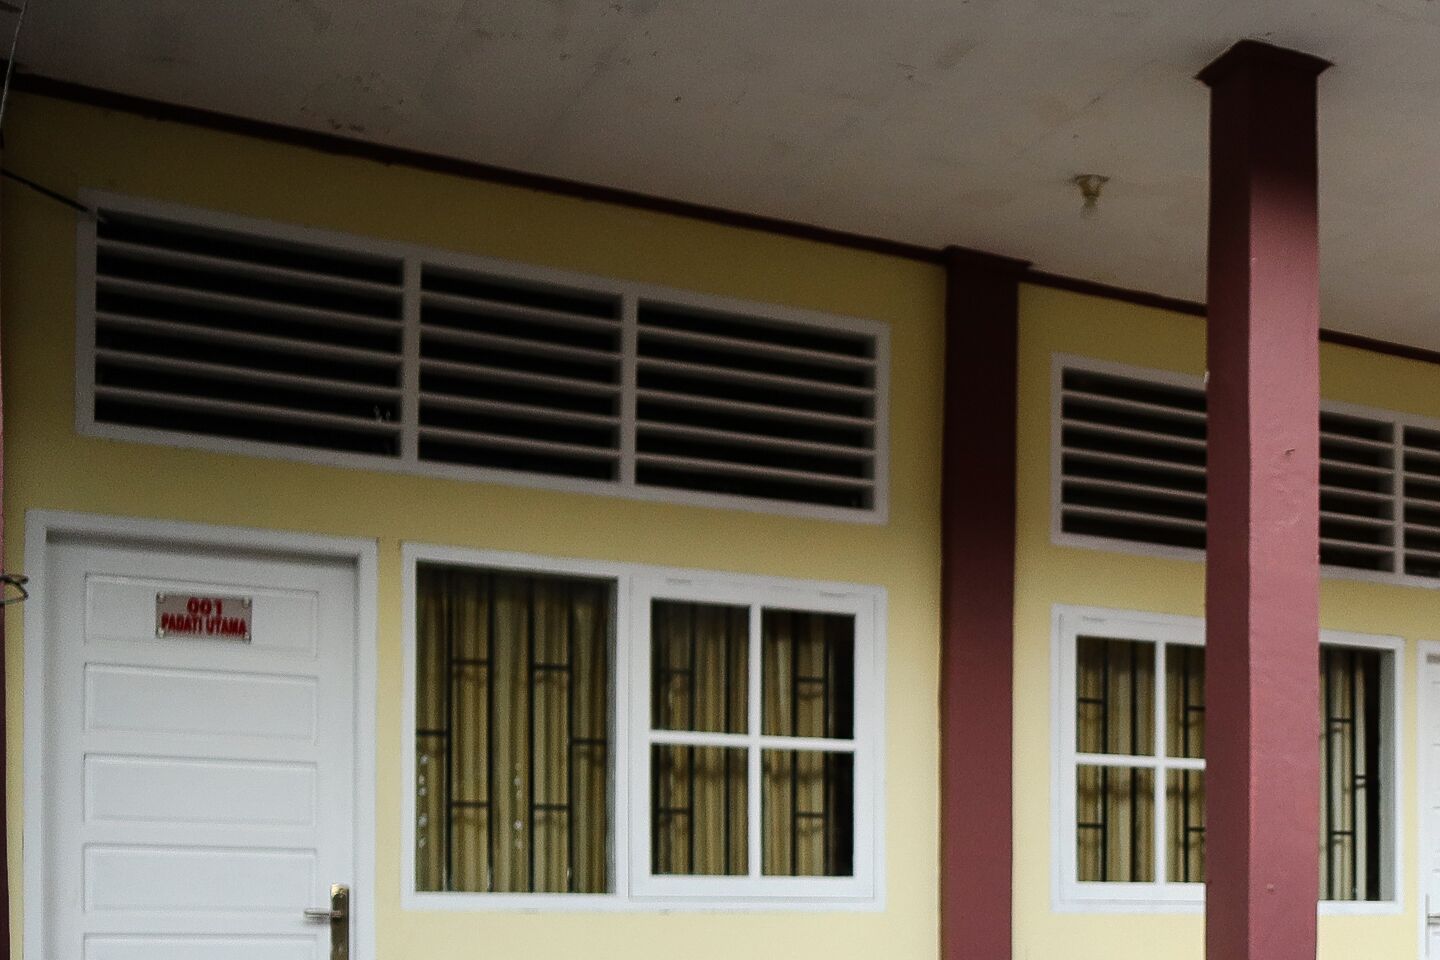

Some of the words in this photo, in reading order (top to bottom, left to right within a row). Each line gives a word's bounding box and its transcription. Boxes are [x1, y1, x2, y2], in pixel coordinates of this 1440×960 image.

[186, 596, 223, 615] 001
[161, 612, 202, 634] PADATI
[206, 616, 247, 637] UTAMA
